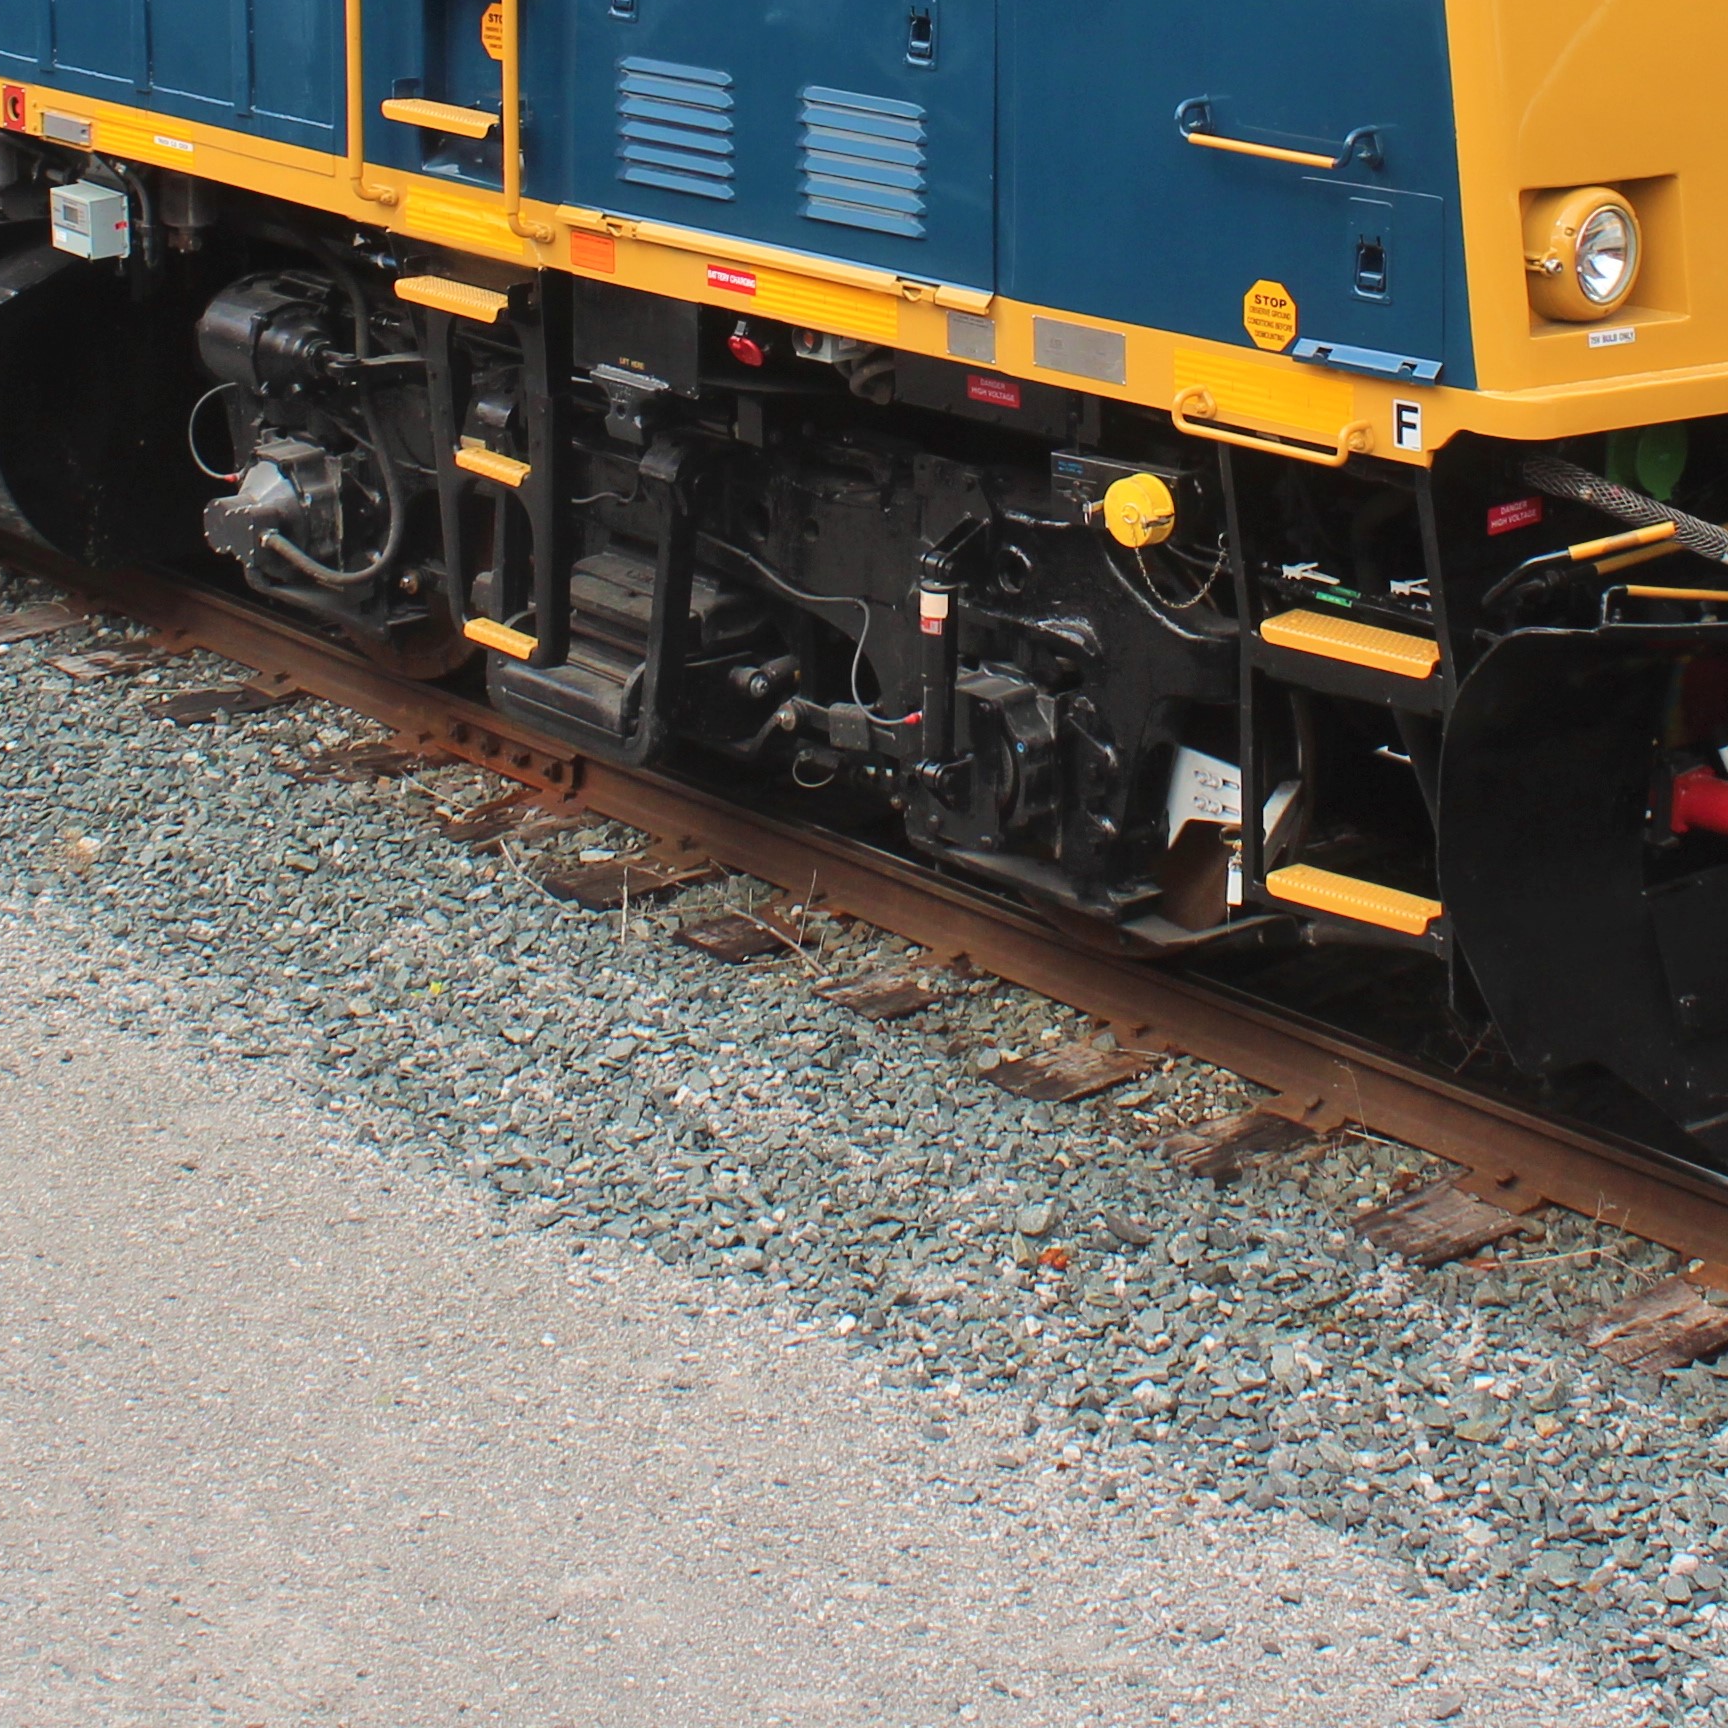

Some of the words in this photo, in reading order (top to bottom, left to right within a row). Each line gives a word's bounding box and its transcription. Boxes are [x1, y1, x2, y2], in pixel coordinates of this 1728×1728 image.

[1255, 294, 1287, 309] STOP
[980, 377, 1006, 390] DANGER
[971, 386, 988, 397] HIGH
[988, 390, 1015, 402] VOLTAGE
[1396, 403, 1419, 446] F
[1500, 500, 1528, 515] DANGER
[1491, 517, 1508, 528] HIGH
[1508, 509, 1537, 523] VOLTAGE
